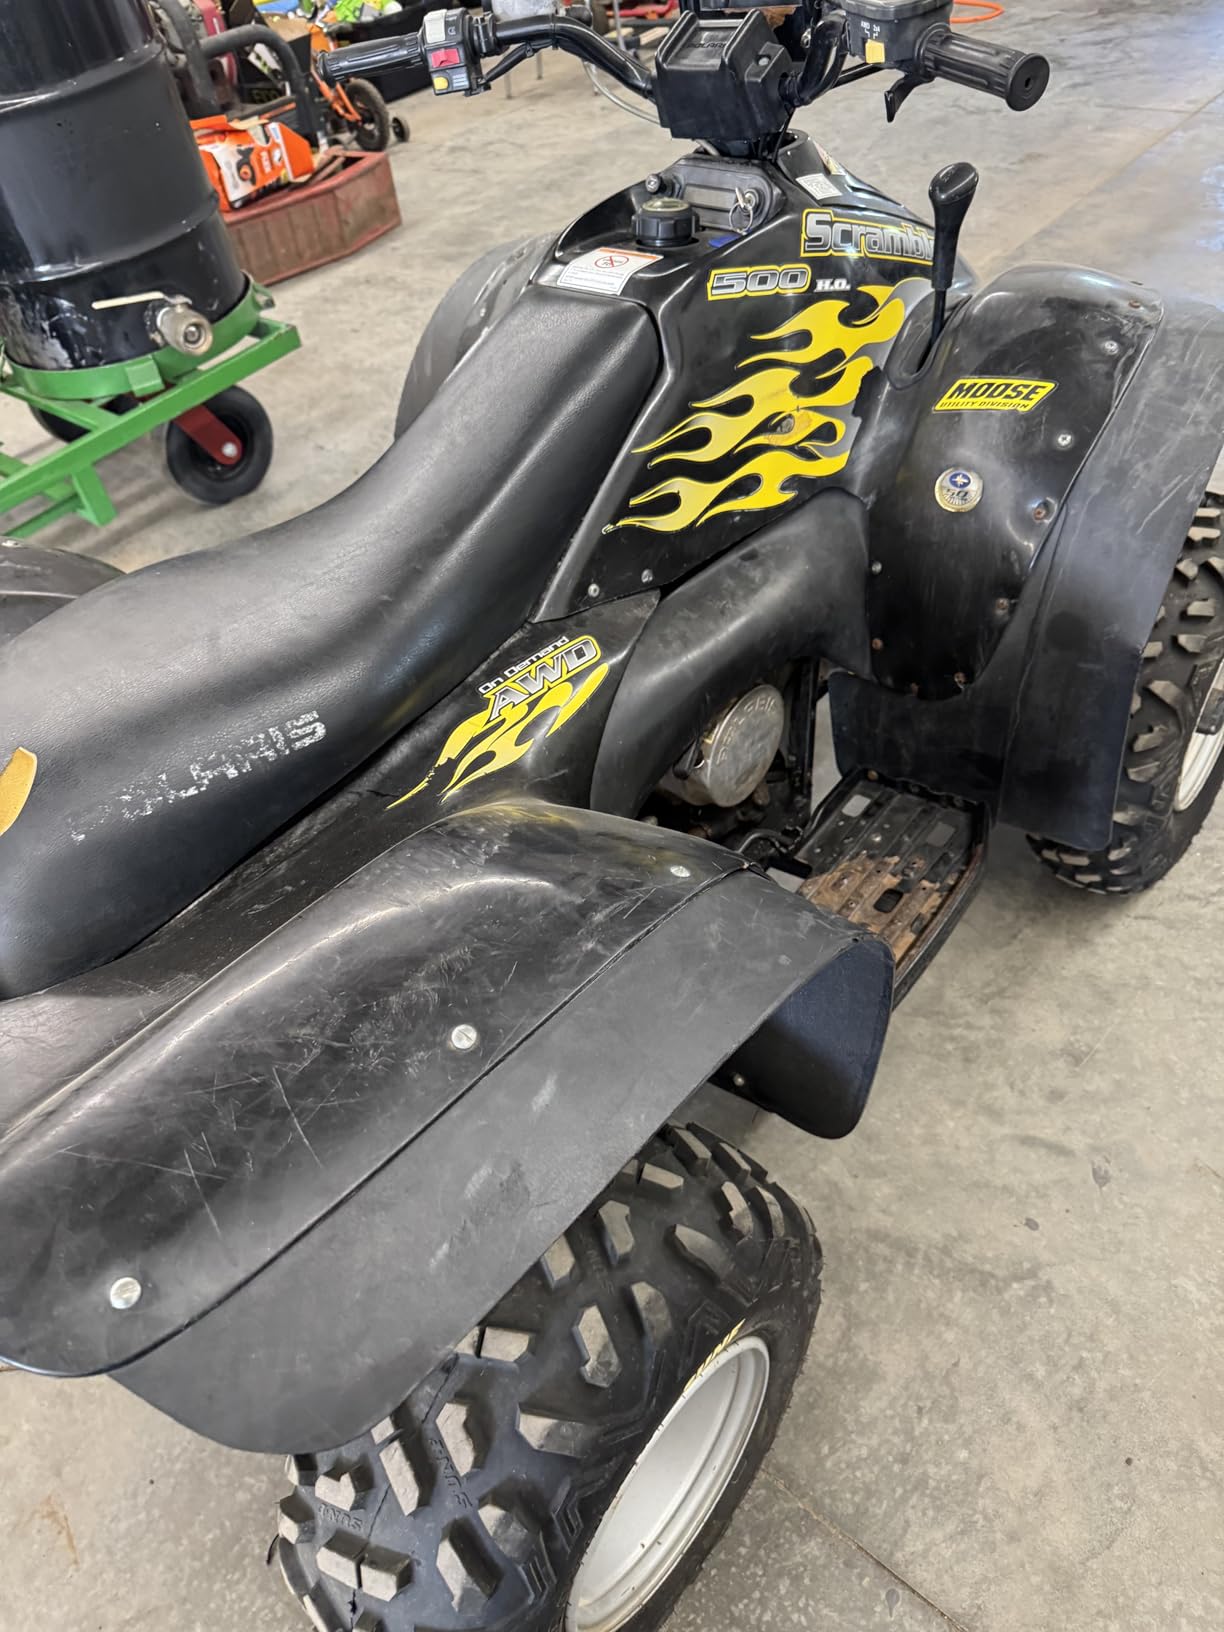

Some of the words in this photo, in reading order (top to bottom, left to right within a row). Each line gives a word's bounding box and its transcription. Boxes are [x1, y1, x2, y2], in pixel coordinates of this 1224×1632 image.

[711, 268, 809, 295] 500
[947, 382, 1048, 401] MOOSE
[939, 401, 978, 409] UTILITY
[978, 401, 1030, 410] DIVISION
[478, 676, 504, 695] On
[503, 635, 570, 678] Demand
[489, 638, 598, 722] AWD
